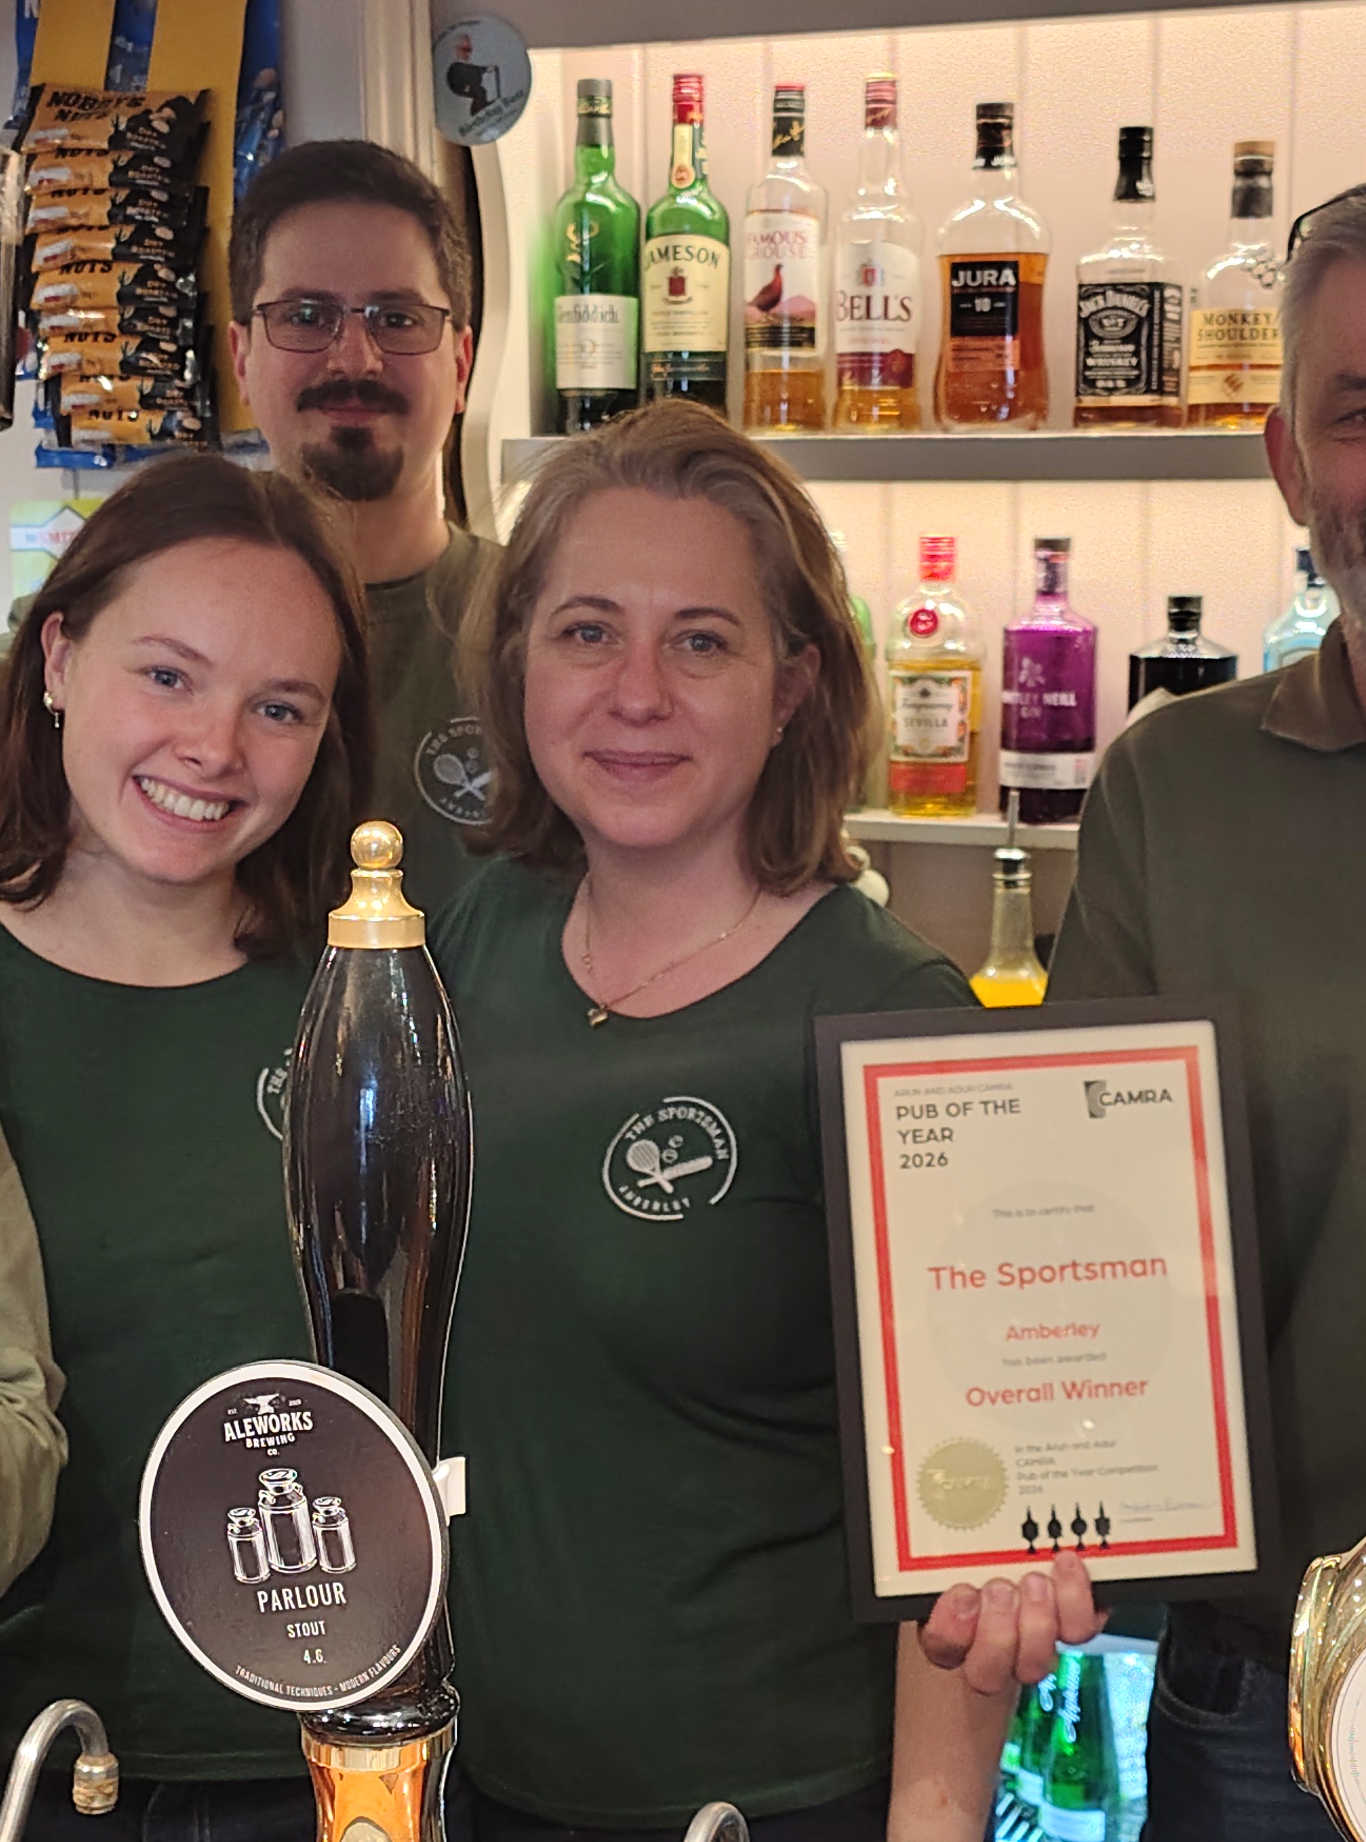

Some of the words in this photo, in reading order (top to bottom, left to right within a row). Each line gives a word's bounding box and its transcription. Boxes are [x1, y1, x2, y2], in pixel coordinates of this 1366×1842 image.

[951, 267, 1016, 287] JURA
[835, 290, 913, 322] BELL'S
[1202, 313, 1273, 326] MONKEY
[1099, 1089, 1174, 1107] CAMRA
[896, 1103, 939, 1121] PUB
[945, 1102, 973, 1118] OF
[979, 1098, 1021, 1116] THE
[624, 1114, 654, 1140] THE
[658, 1105, 729, 1160] SPORTSMAN
[897, 1127, 954, 1146] YEAR
[899, 1152, 949, 1170] 2026
[927, 1265, 986, 1291] The
[997, 1257, 1168, 1290] Sportsman
[1005, 1322, 1101, 1343] Amberley
[965, 1382, 1055, 1408] Overall
[1061, 1378, 1150, 1401] Winner
[224, 1411, 314, 1442] ALEWORKS
[245, 1433, 296, 1448] BREWING
[257, 1582, 347, 1613] PARLOUR
[287, 1620, 327, 1638] STOUT
[235, 1665, 284, 1695] TRADITIONAL
[286, 1685, 333, 1697] TECHNIQUES
[339, 1672, 370, 1692] MODERN
[369, 1644, 402, 1678] FLAVOURS
